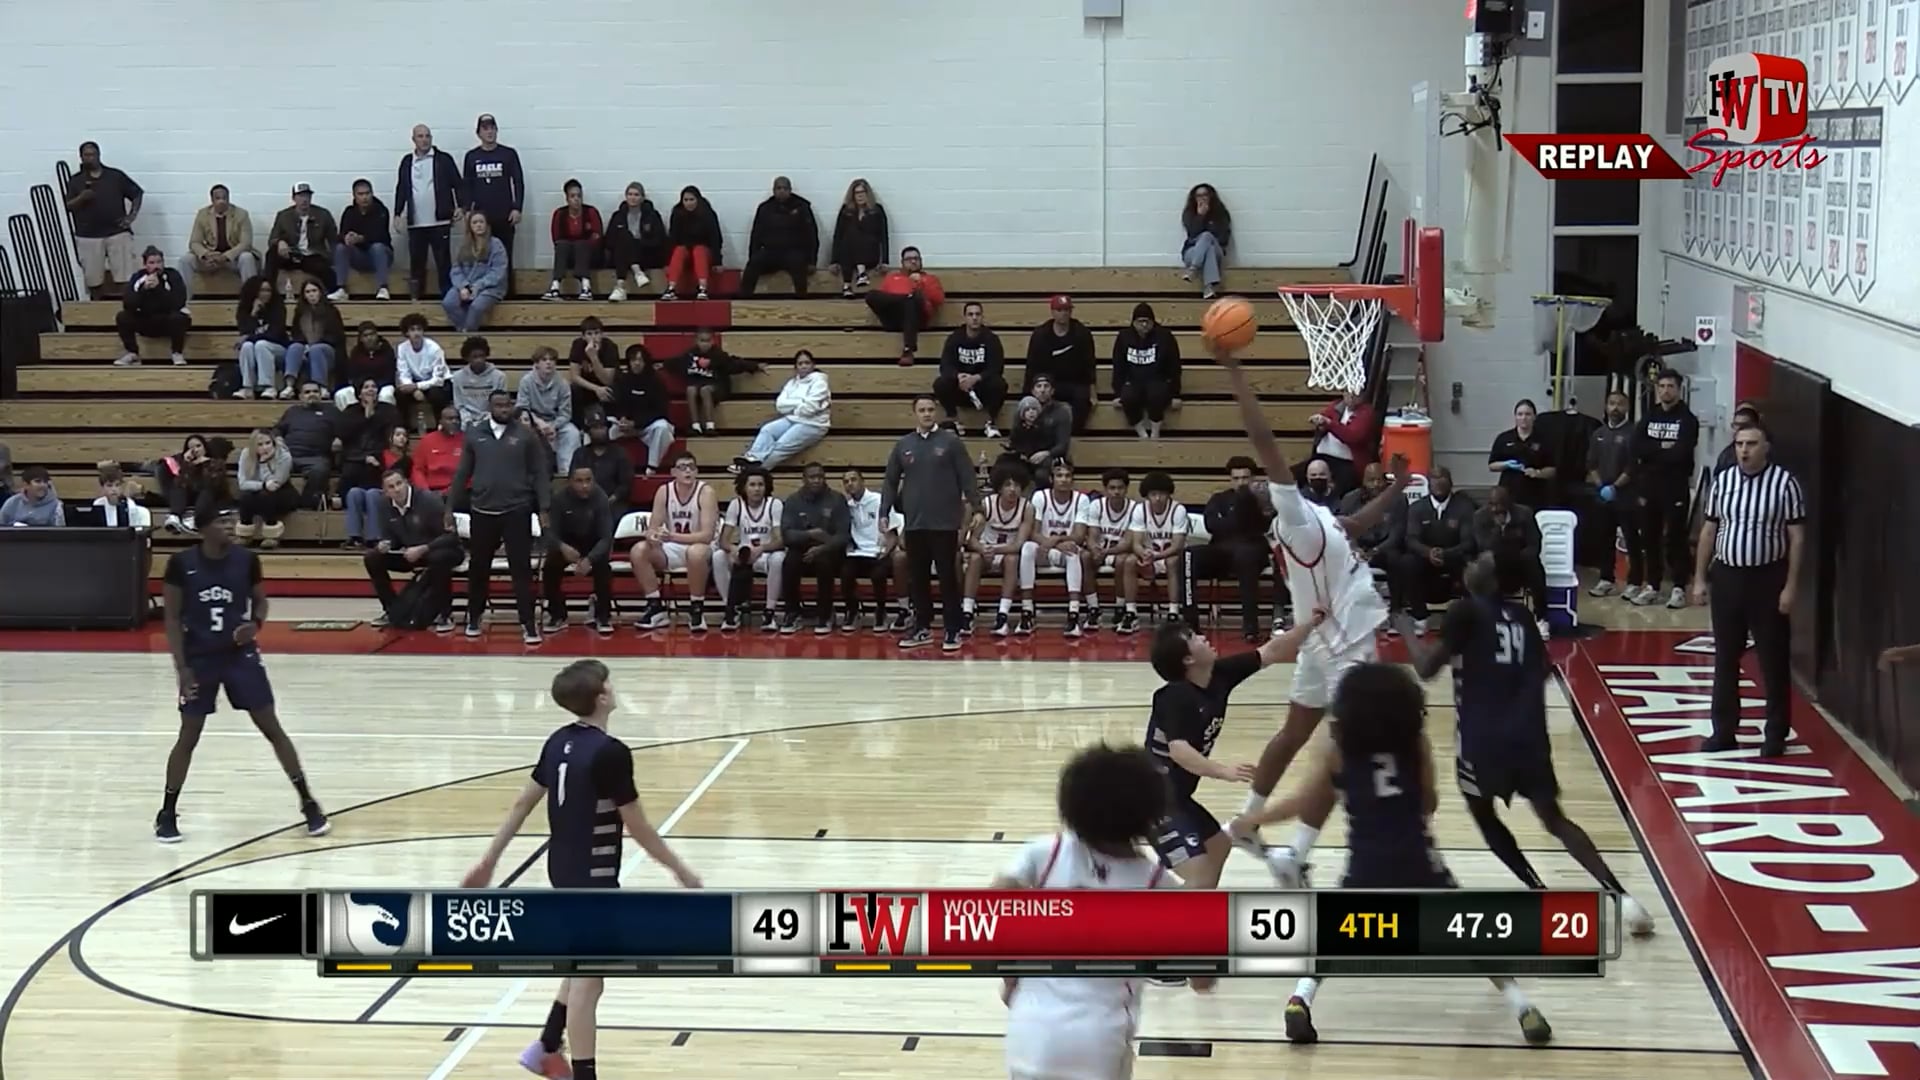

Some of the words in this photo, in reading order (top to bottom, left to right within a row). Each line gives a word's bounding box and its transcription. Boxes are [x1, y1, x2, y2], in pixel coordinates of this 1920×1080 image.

[475, 163, 503, 173] EAGLE
[1698, 318, 1714, 326] AED
[198, 586, 233, 603] SGA
[210, 607, 224, 631] 5
[1495, 622, 1525, 666] 34
[557, 762, 568, 808] 1
[1371, 752, 1403, 797] 2
